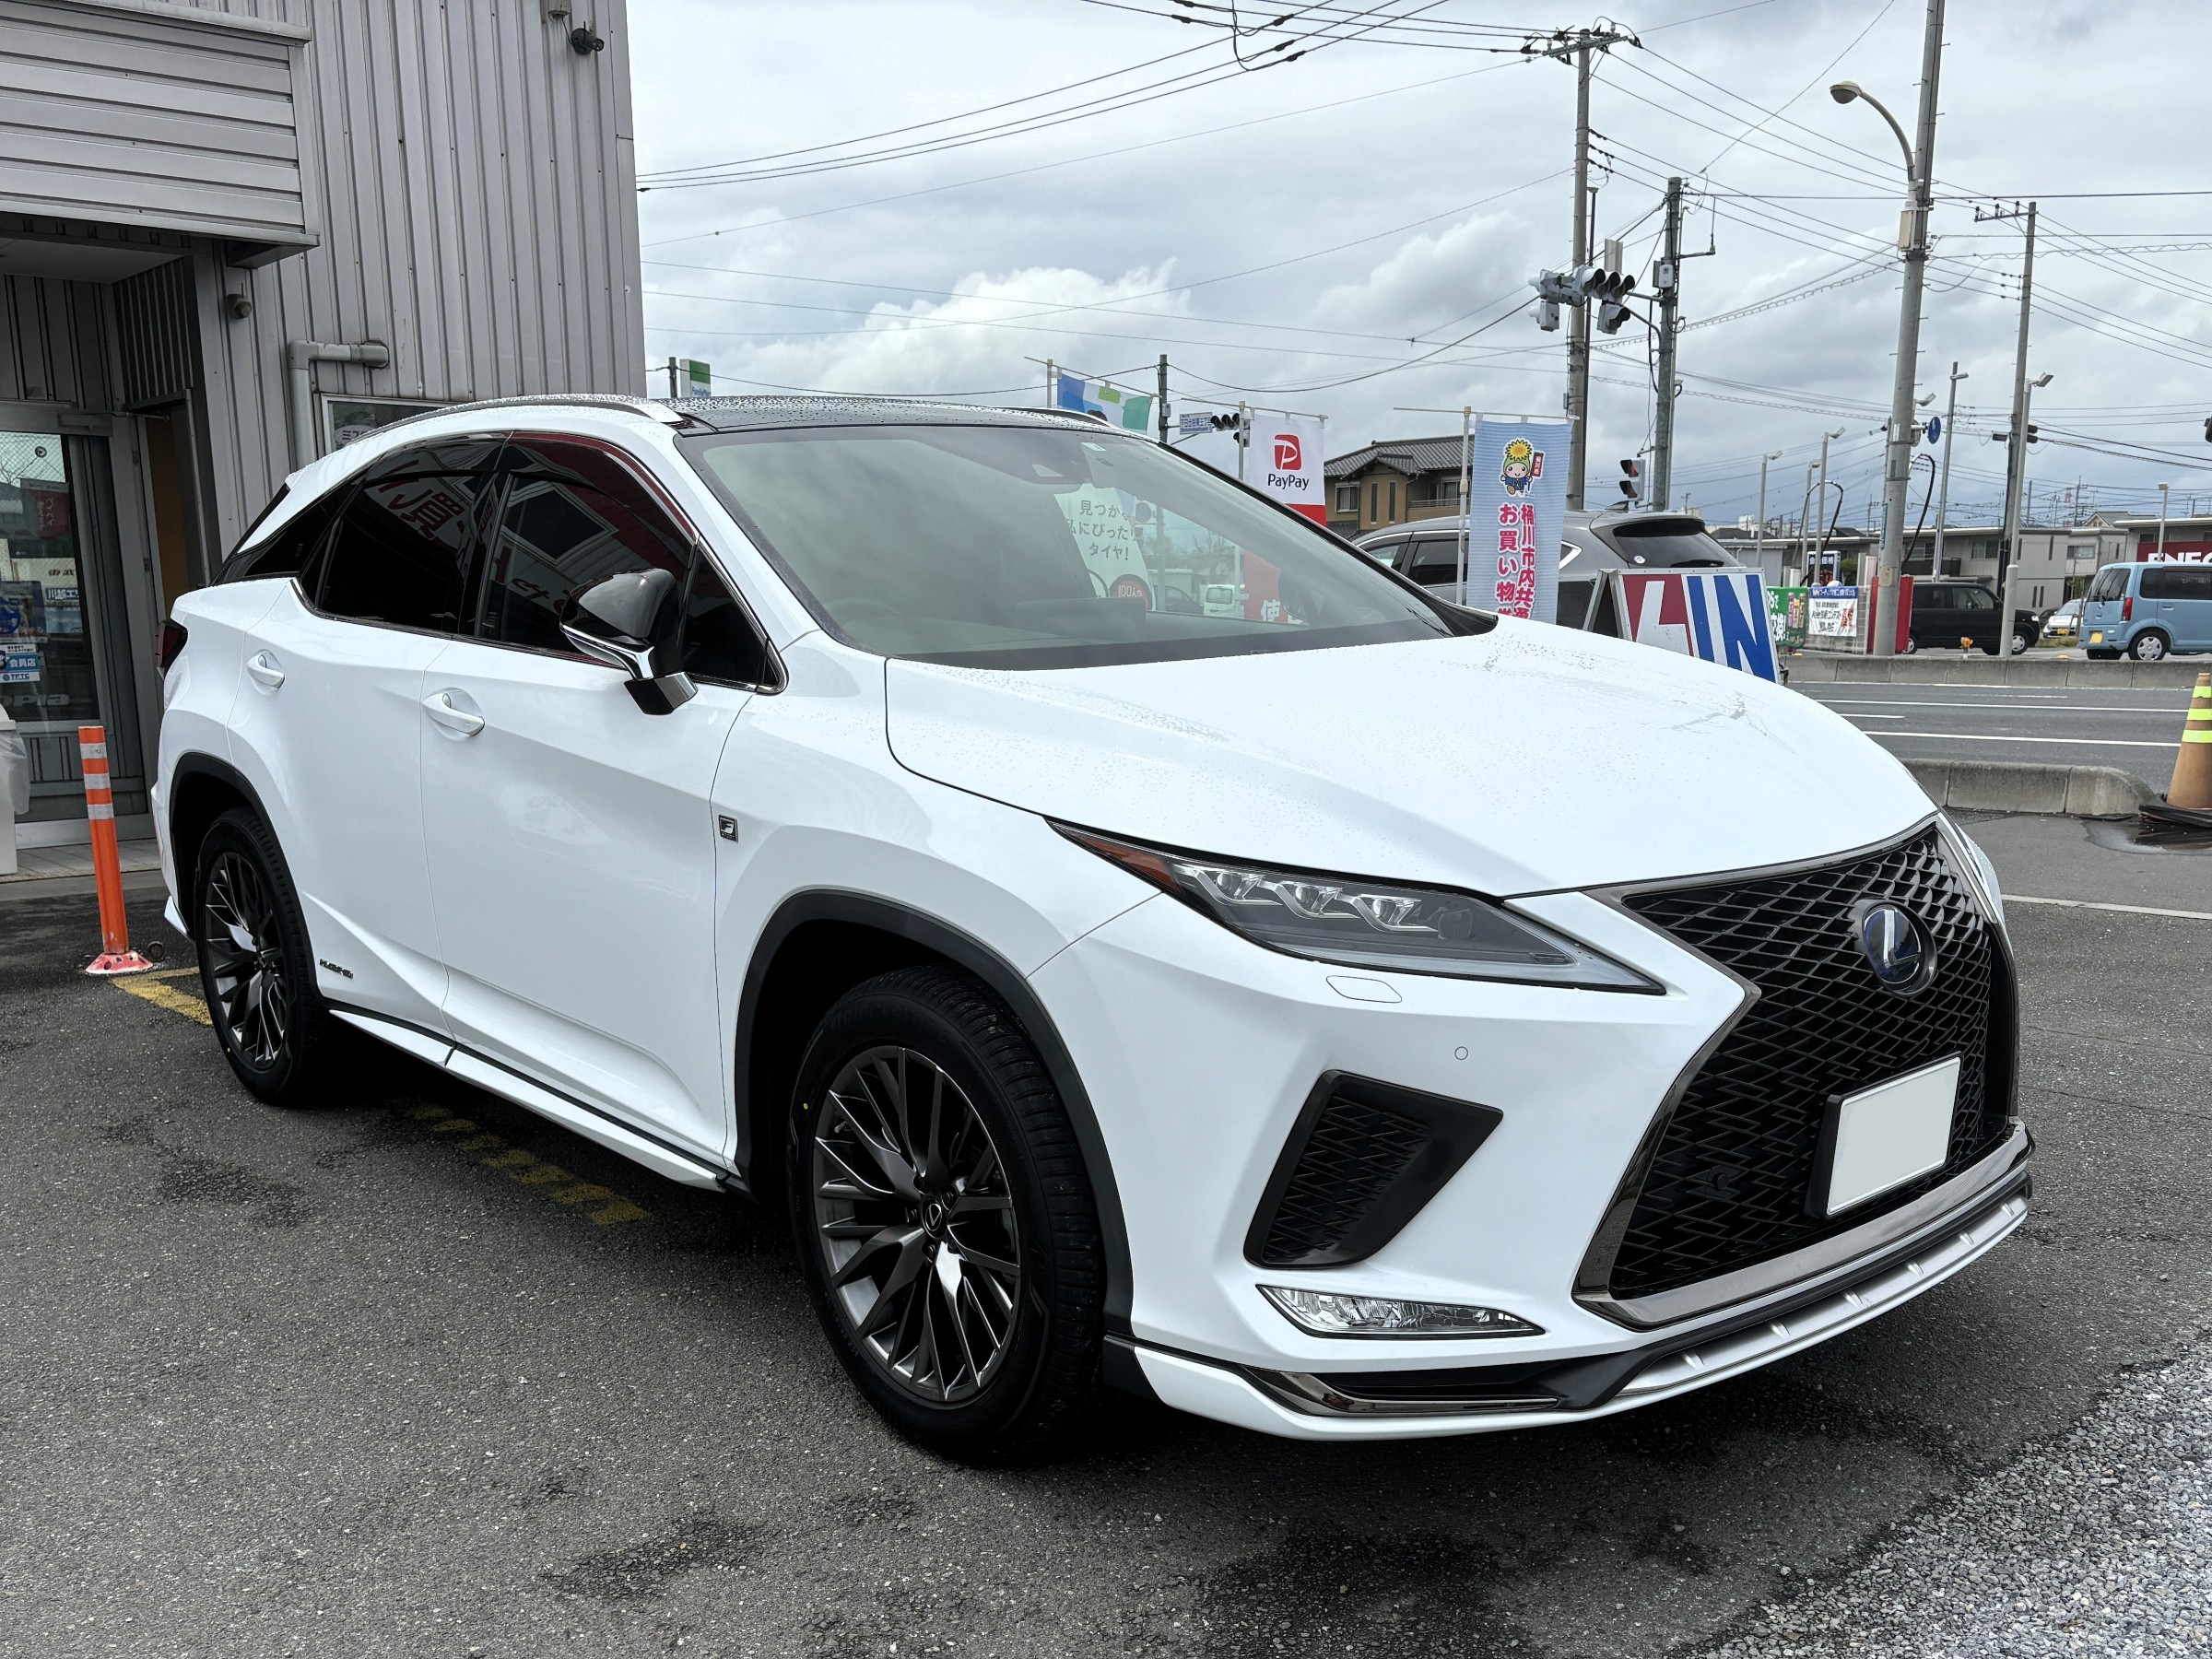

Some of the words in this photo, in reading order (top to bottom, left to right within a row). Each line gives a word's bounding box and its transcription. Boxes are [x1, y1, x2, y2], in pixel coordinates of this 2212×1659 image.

[1267, 473, 1310, 491] PayPay
[1497, 504, 1519, 616] お買い物
[8, 658, 36, 668] 会員店
